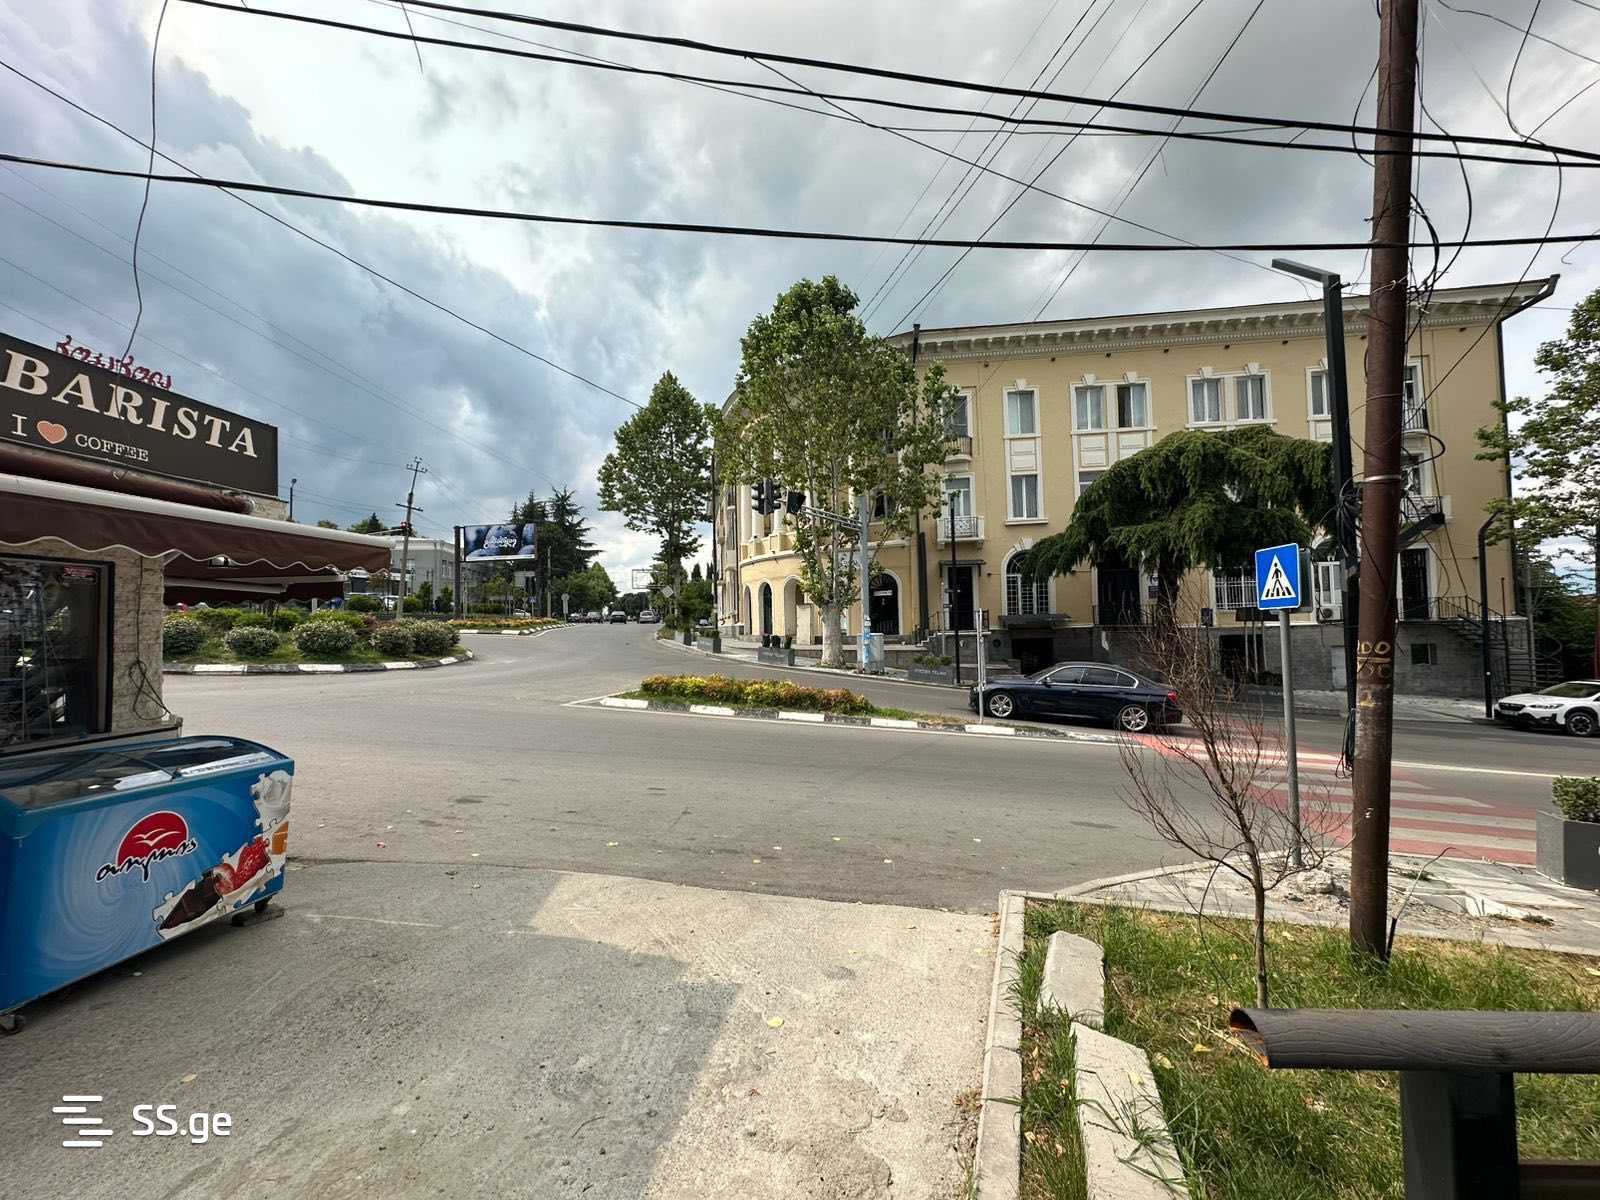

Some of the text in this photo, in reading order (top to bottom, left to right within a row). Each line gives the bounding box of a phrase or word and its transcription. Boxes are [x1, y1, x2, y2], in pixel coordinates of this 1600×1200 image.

[0, 349, 258, 458] BARISTA
[11, 413, 149, 462] I COFFEE
